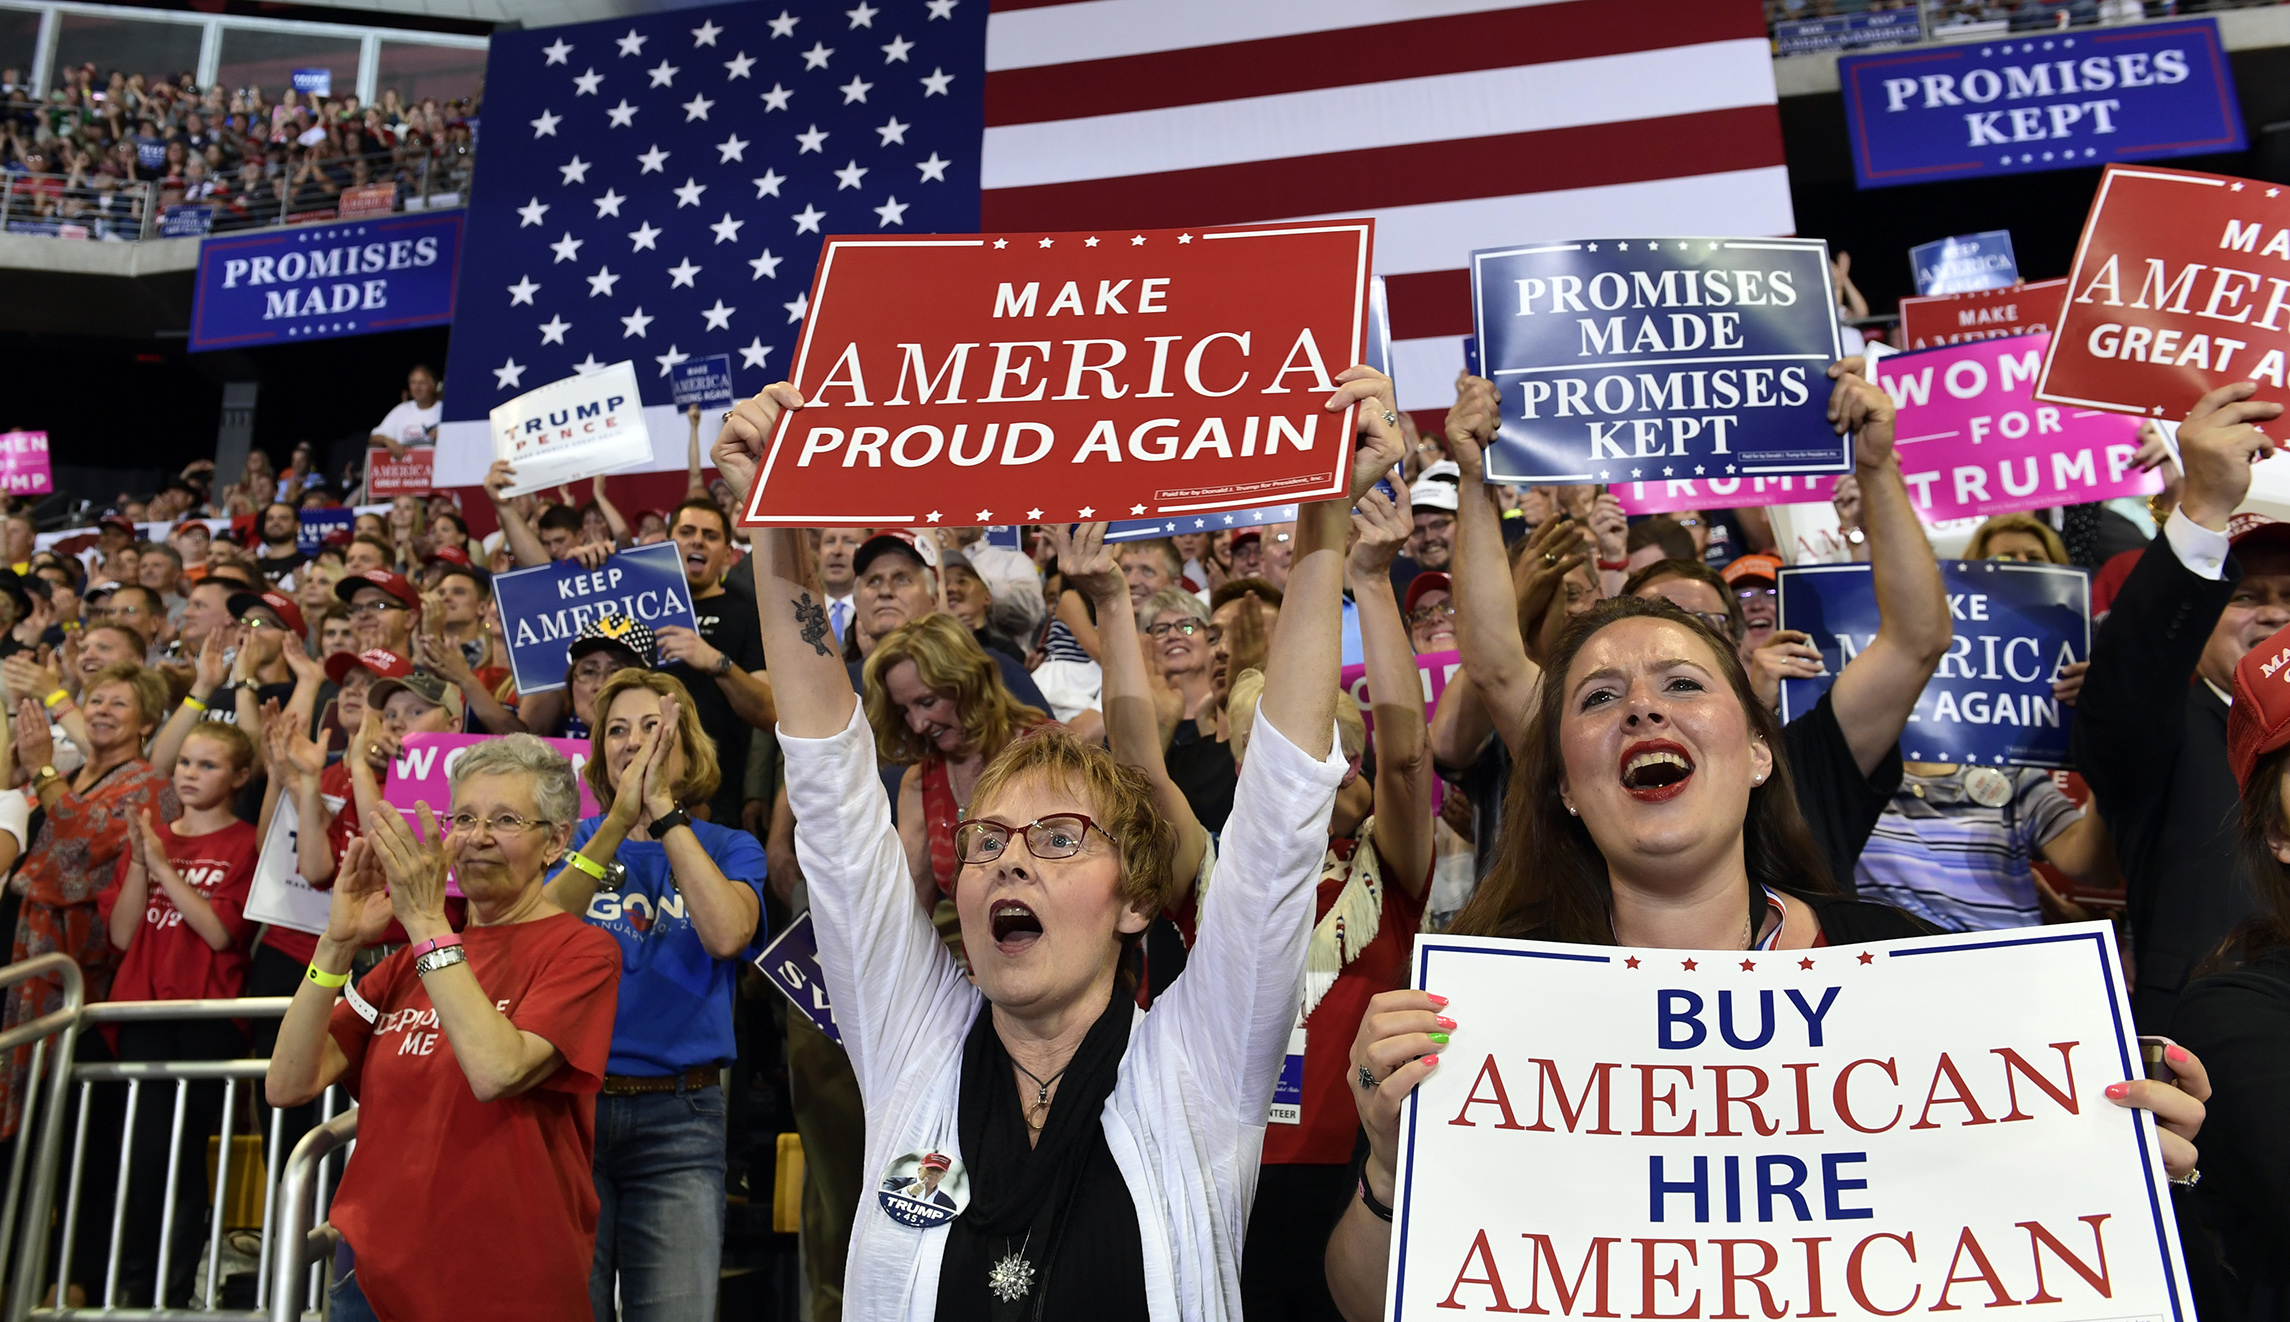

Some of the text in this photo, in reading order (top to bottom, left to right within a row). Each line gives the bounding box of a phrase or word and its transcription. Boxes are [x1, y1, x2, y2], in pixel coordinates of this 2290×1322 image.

[1882, 49, 2190, 113] PROMISES
[1963, 99, 2121, 147] KEPT
[222, 236, 437, 289] PROMISES
[262, 278, 388, 320] MADE
[991, 277, 1172, 319] MAKE
[1514, 269, 1798, 317] PROMISES
[1958, 304, 2018, 327] MAKE
[1577, 311, 1744, 357] MADE
[2087, 323, 2247, 373] GREAT
[803, 327, 1339, 409] AMERICA
[1880, 350, 2042, 411] WOM
[1519, 366, 1810, 420] PROMISES
[505, 396, 624, 441] TRUMP
[516, 417, 618, 451] PENCE
[796, 413, 1320, 469] PROUD AGAIN
[1586, 415, 1739, 462] KEPT
[1969, 406, 2063, 445] FOR
[1904, 443, 2138, 511] TRUMP
[557, 568, 622, 600] KEEP
[1946, 594, 1989, 621] KE
[1933, 691, 2060, 728] AGAIN
[1657, 985, 1843, 1051] BUY
[397, 1031, 439, 1056] ME
[1448, 1040, 2081, 1138] AMERICAN
[887, 1196, 945, 1220] TRUMP
[1649, 1151, 1875, 1224] HIRE
[903, 1213, 918, 1223] 45
[1436, 1212, 2113, 1320] AMERICAN
